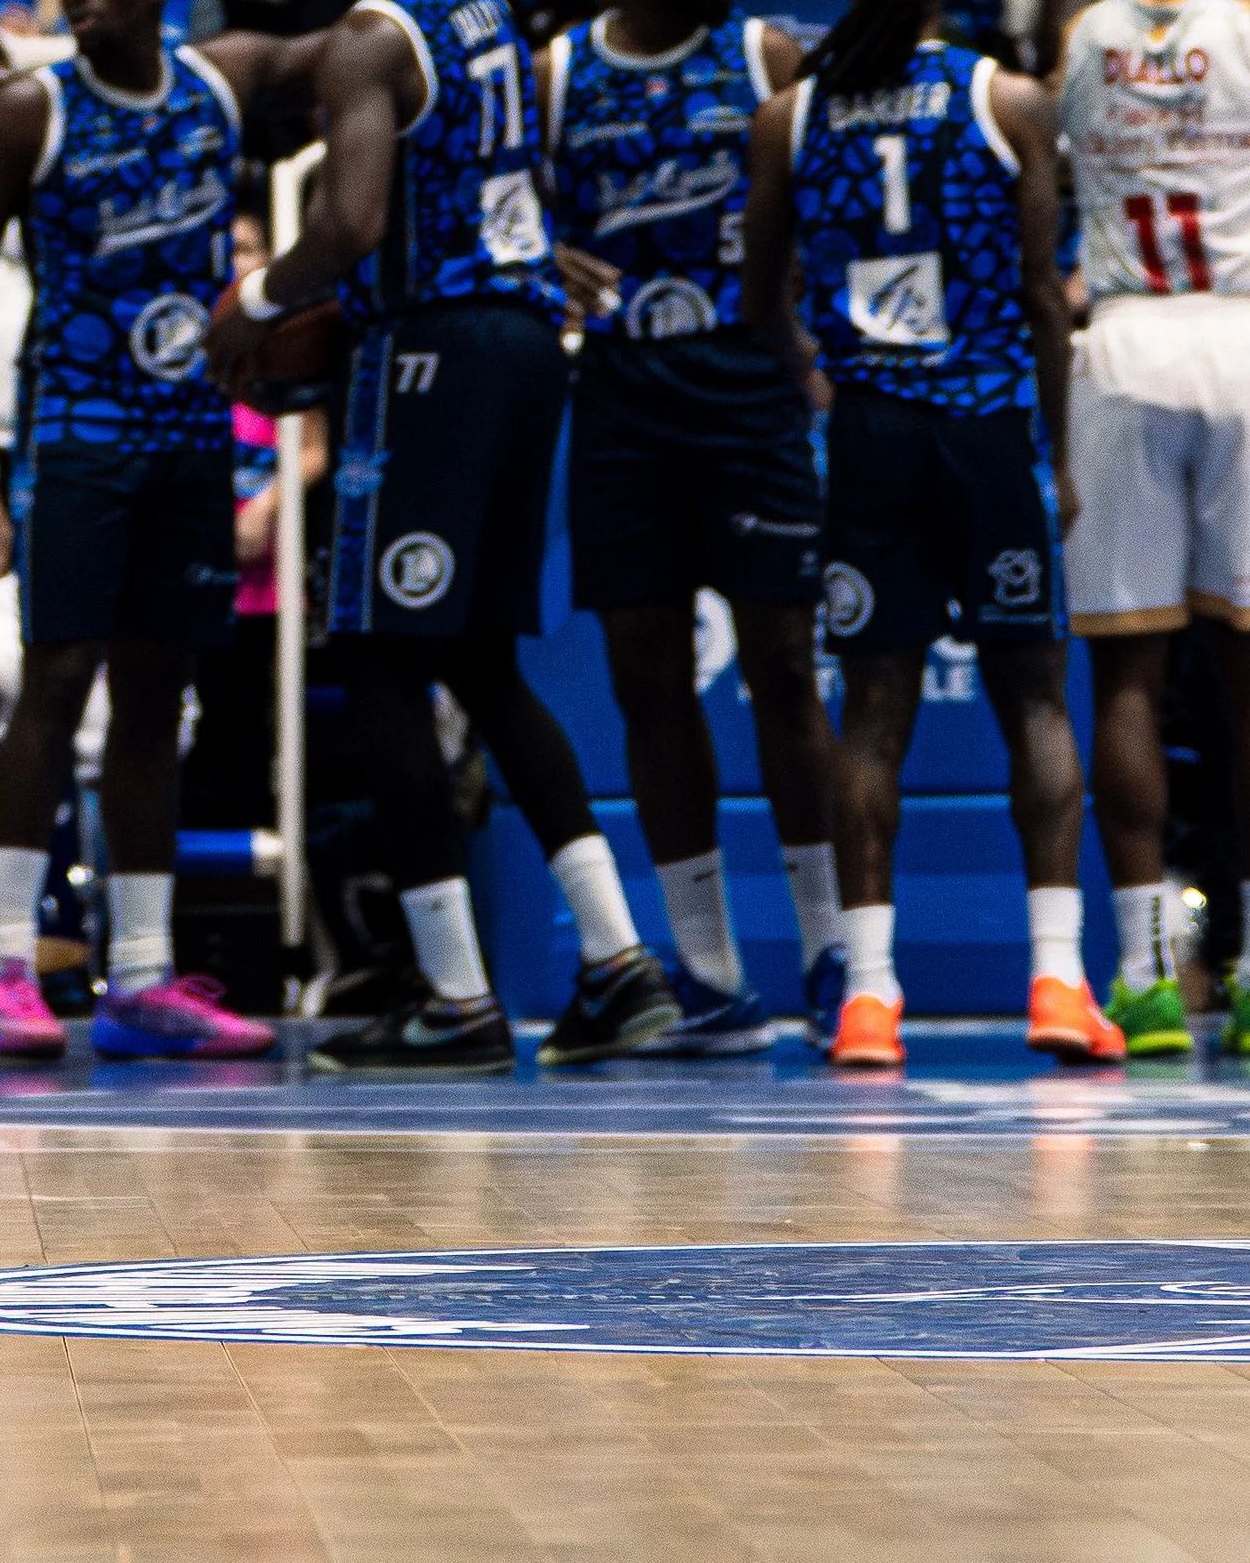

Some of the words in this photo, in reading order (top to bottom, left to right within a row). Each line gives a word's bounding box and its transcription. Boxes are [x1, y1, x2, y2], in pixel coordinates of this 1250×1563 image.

[467, 41, 523, 159] 77
[873, 134, 912, 235] 1
[395, 352, 441, 394] 77
